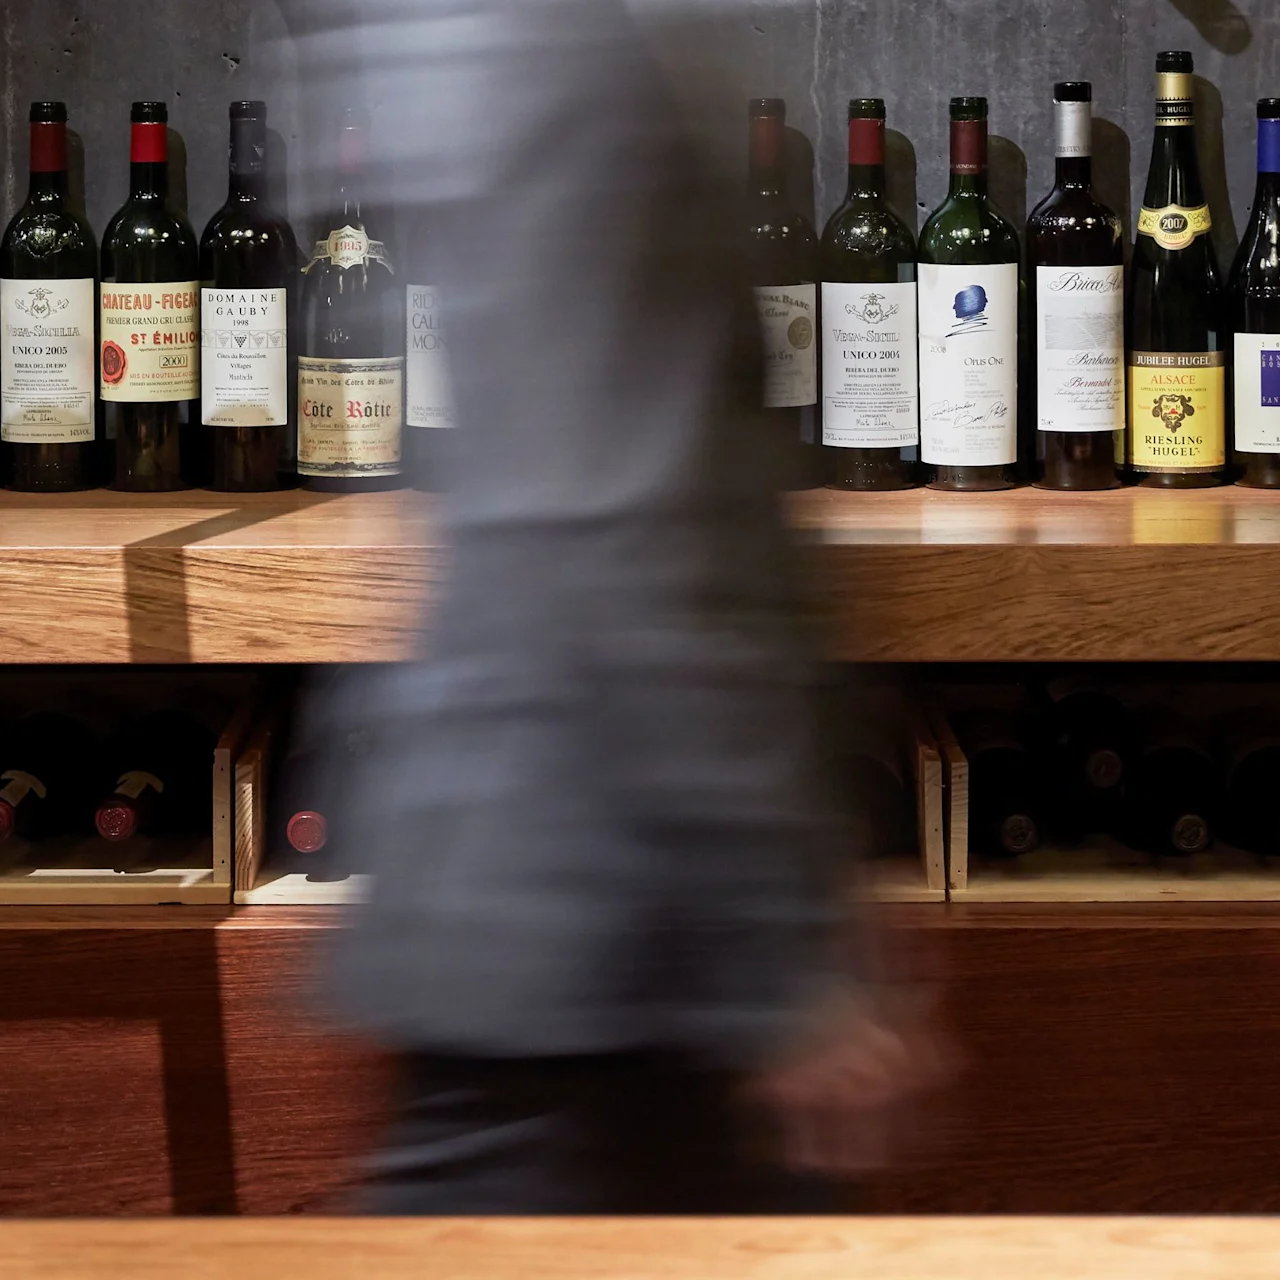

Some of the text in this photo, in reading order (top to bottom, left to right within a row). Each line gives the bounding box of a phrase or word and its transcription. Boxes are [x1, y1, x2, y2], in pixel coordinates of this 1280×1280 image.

[1162, 216, 1185, 229] 2007
[333, 241, 362, 251] 1995
[1048, 271, 1103, 293] Bricco
[208, 294, 277, 303] DOMAINE
[782, 295, 810, 311] BLANC
[216, 307, 268, 316] GAUBY
[131, 316, 159, 325] GRAND
[159, 316, 173, 325] CRU
[232, 319, 249, 327] 1998
[12, 346, 68, 356] UNICO 2005
[843, 350, 877, 360] UNICO
[162, 356, 186, 367] 2000
[964, 356, 1004, 366] OPUS ONE
[1136, 355, 1211, 366] JUBILEE HUGEL
[1150, 375, 1196, 385] ALSACE
[302, 399, 333, 418] Côte
[346, 399, 391, 418] Rôtie
[1145, 435, 1203, 445] RIESLING
